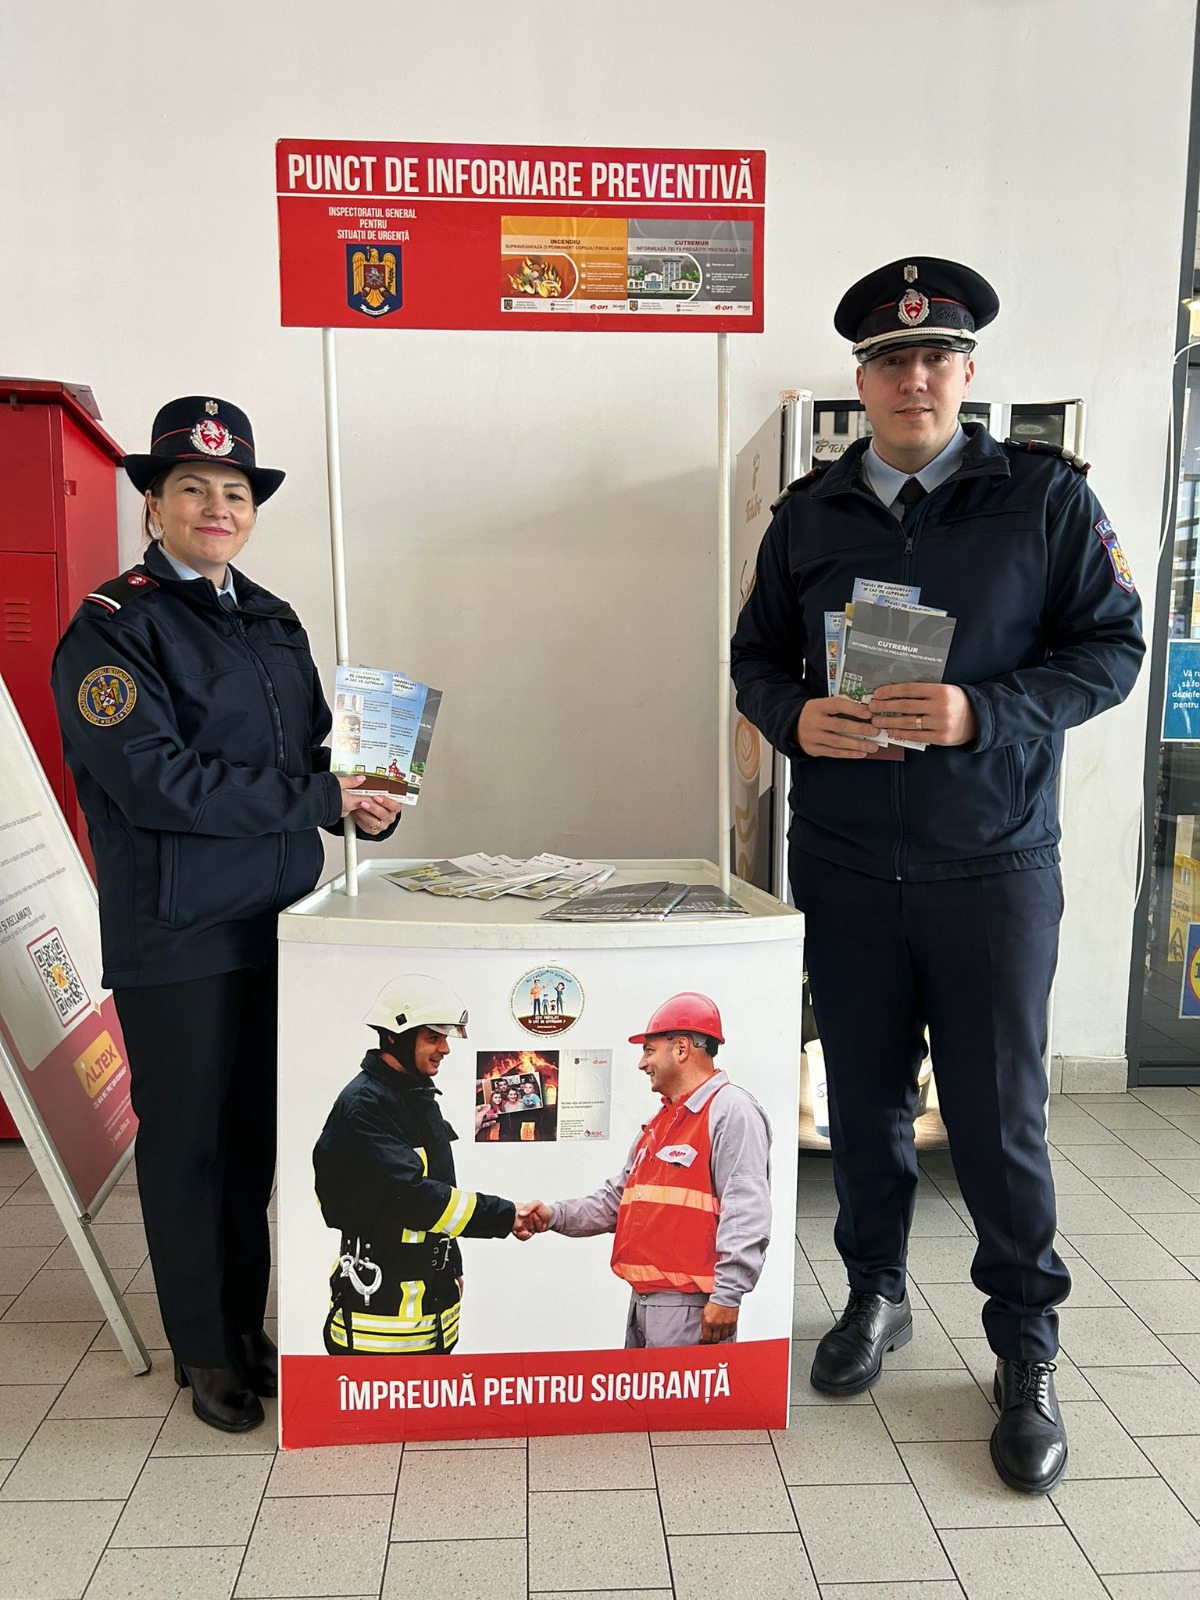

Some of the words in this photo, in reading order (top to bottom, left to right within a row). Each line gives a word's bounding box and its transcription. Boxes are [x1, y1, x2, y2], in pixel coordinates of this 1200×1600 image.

[288, 154, 375, 192] PUNCT
[385, 157, 420, 192] DE
[427, 158, 583, 197] INFORMARE
[591, 157, 754, 200] PREVENTIVĂ
[328, 206, 384, 218] INSPECTORATUL
[385, 208, 417, 219] GENERAL
[359, 219, 387, 229] PENTRU
[367, 230, 377, 240] DE
[877, 640, 919, 654] CUTREMUR
[1183, 669, 1193, 677] Vă
[1181, 680, 1191, 688] să
[1173, 702, 1199, 710] pentru
[337, 1372, 477, 1411] ÎMPREUNĂ
[484, 1374, 584, 1407] PENTRU
[591, 1362, 731, 1405] SIGURANȚĂ
